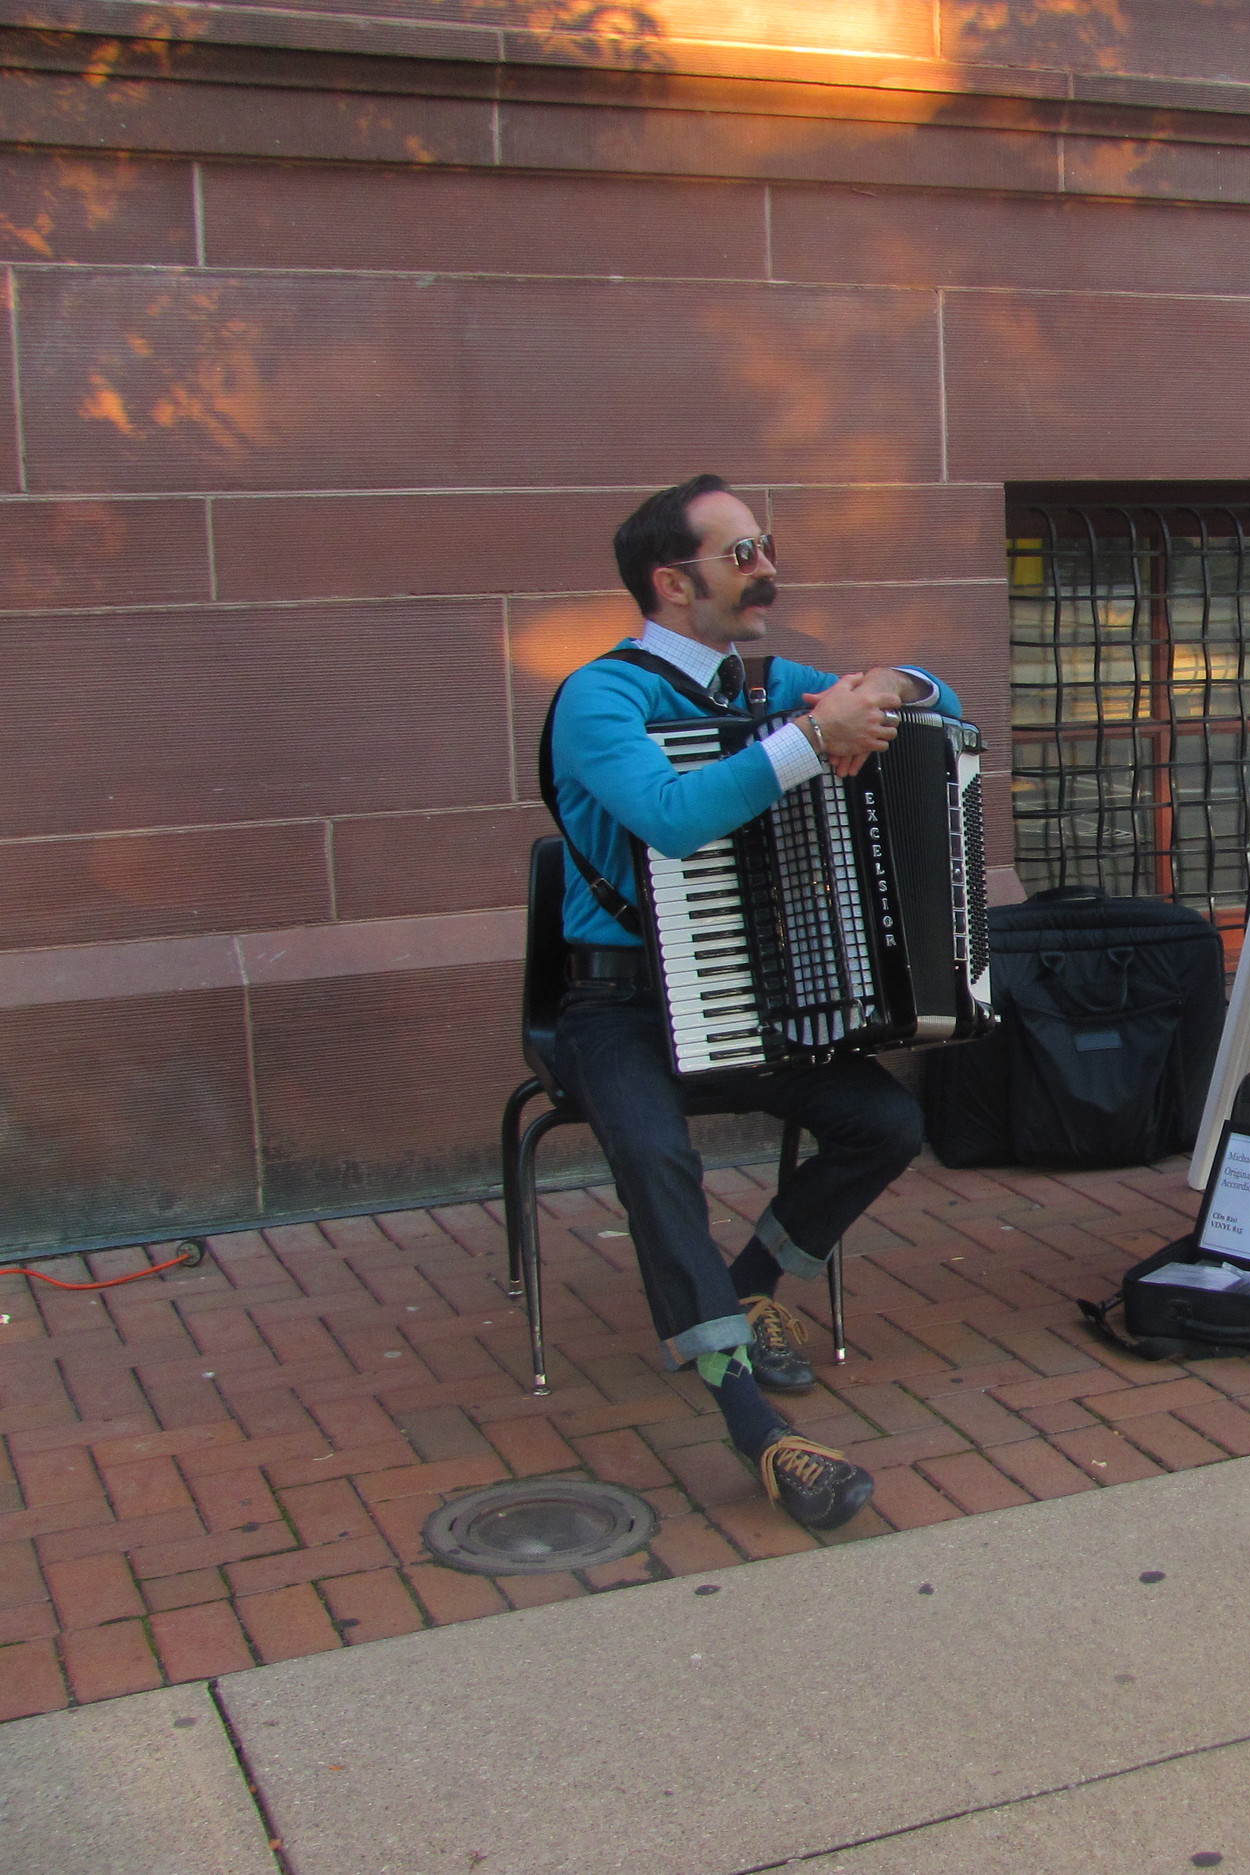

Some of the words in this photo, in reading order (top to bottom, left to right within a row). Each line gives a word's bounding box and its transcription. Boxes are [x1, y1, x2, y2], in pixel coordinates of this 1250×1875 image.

[864, 791, 897, 947] EXCELSIOR
[1212, 1212, 1226, 1221] CDs
[1211, 1220, 1231, 1231] VINYL
